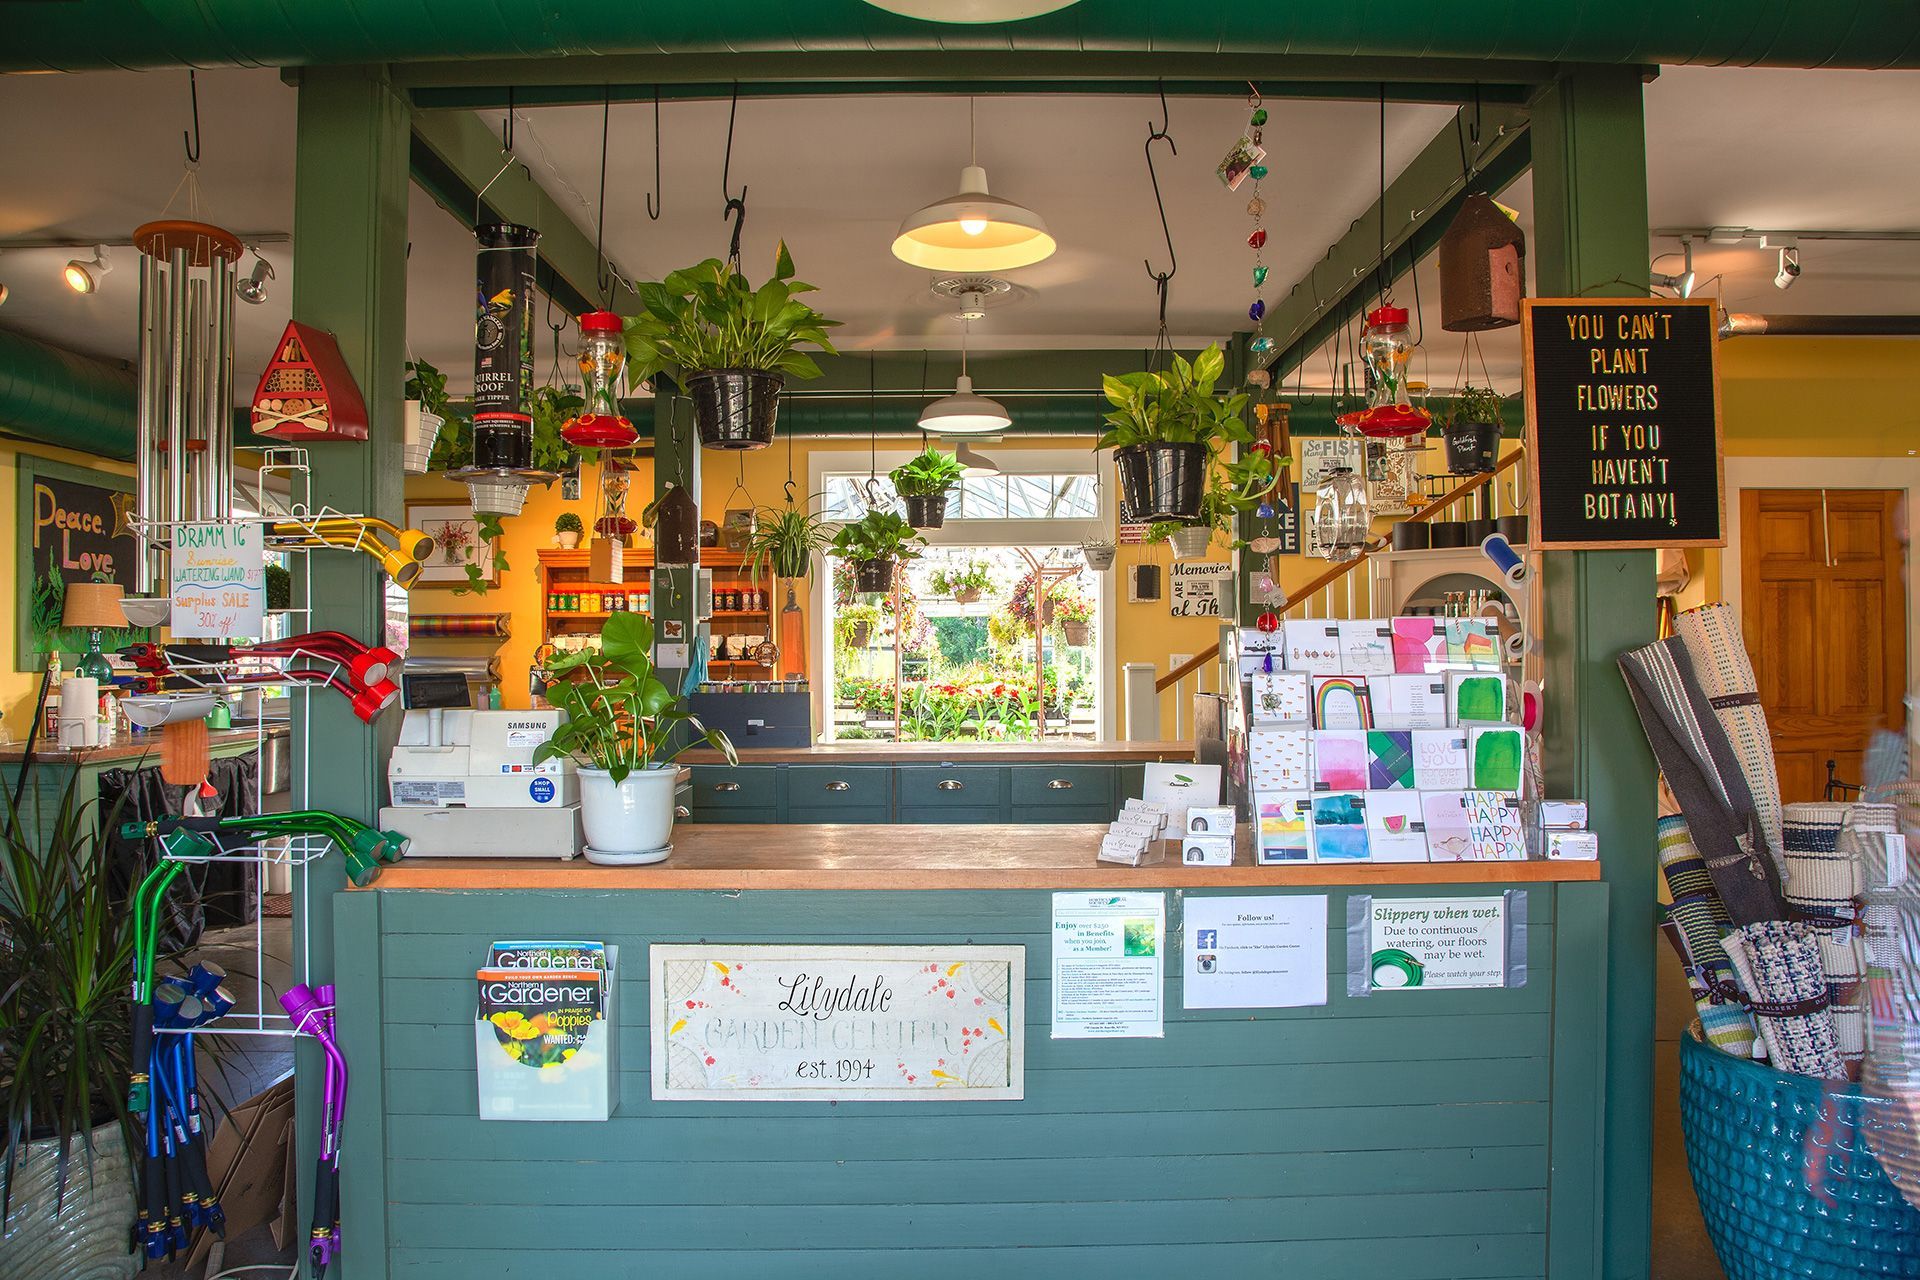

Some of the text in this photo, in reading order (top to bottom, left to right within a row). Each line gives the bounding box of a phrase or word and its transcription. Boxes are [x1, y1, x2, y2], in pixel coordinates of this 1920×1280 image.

[1567, 312, 1672, 340] YOU CAN'T
[1591, 348, 1649, 374] PLANT
[1578, 385, 1658, 411] FLOWERS
[1592, 425, 1660, 451] IF YOU
[1323, 440, 1362, 456] FISH
[1591, 456, 1669, 484] HAVEN'T
[1584, 492, 1678, 527] BOTANY!
[177, 526, 227, 549] DRAMM
[173, 567, 219, 582] WATERING
[221, 566, 245, 581] WAND
[1174, 581, 1183, 599] ARE
[176, 592, 249, 614] surplus SALE
[1467, 807, 1518, 823] HAPPY
[1471, 825, 1522, 842] HAPPY
[1473, 842, 1525, 859] HAPPY
[1237, 913, 1275, 922] Follow us!
[1374, 906, 1500, 924] Slippery when wet.
[1055, 921, 1078, 931] Enjoy
[1384, 925, 1479, 936] Due to continuous
[1386, 937, 1488, 950] watering, our floors
[498, 951, 599, 969] Gardener
[1424, 949, 1485, 963] may be wet.
[1424, 968, 1502, 980] Please watch your step.
[489, 980, 594, 1003] Gardener
[778, 972, 894, 1021] Lilydale
[548, 1011, 592, 1032] Poppies
[543, 1034, 575, 1044] WANTED:
[705, 1017, 959, 1055] GARDEN CENTER
[836, 1059, 876, 1081] 1994
